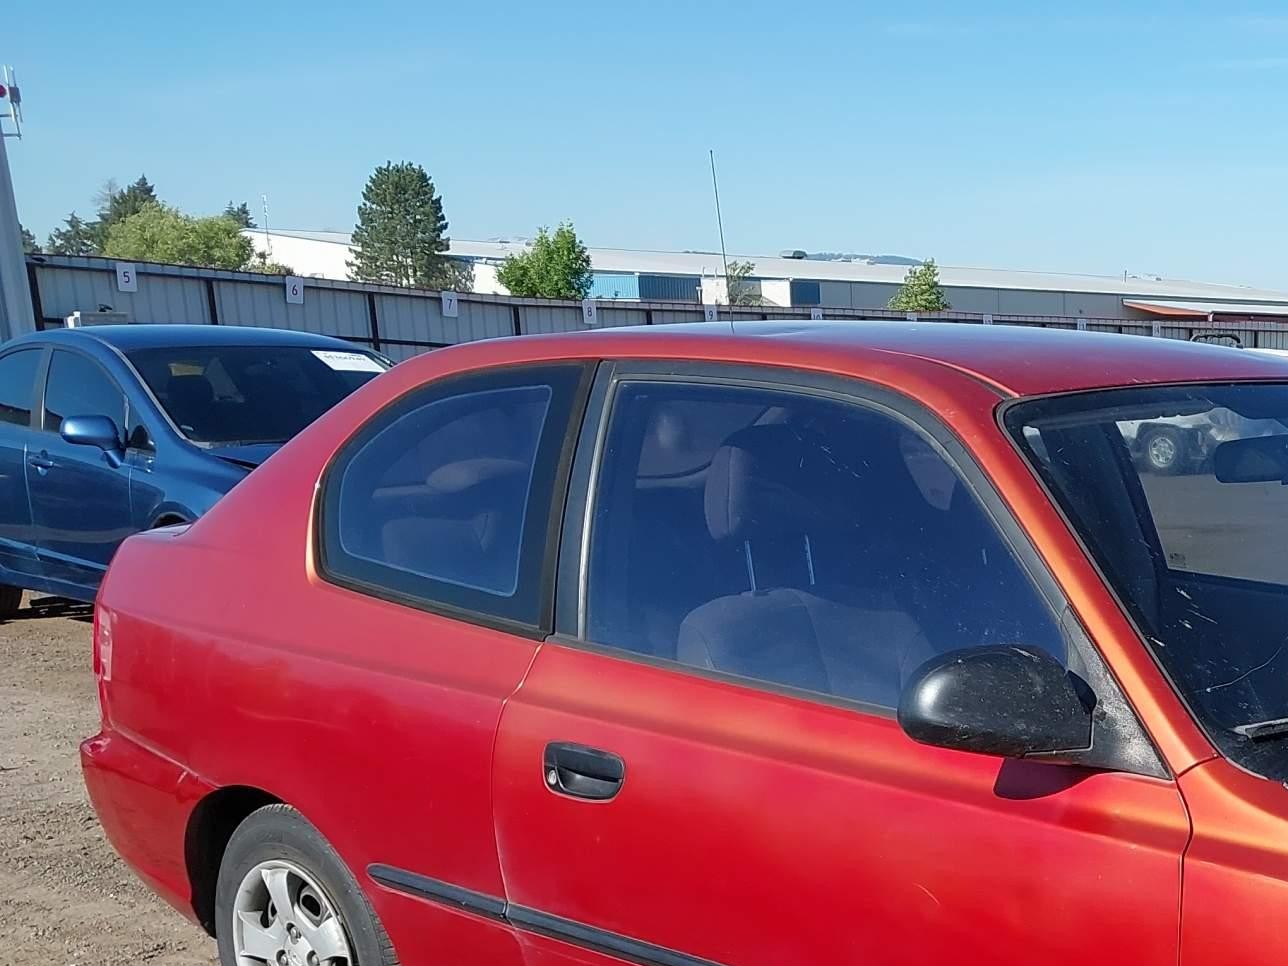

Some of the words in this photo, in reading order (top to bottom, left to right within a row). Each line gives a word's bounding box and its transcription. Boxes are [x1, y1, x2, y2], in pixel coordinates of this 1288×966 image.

[122, 271, 130, 284] 5
[291, 284, 298, 296] 6
[447, 298, 453, 310] 7
[587, 306, 593, 317] 8
[708, 310, 714, 320] 9
